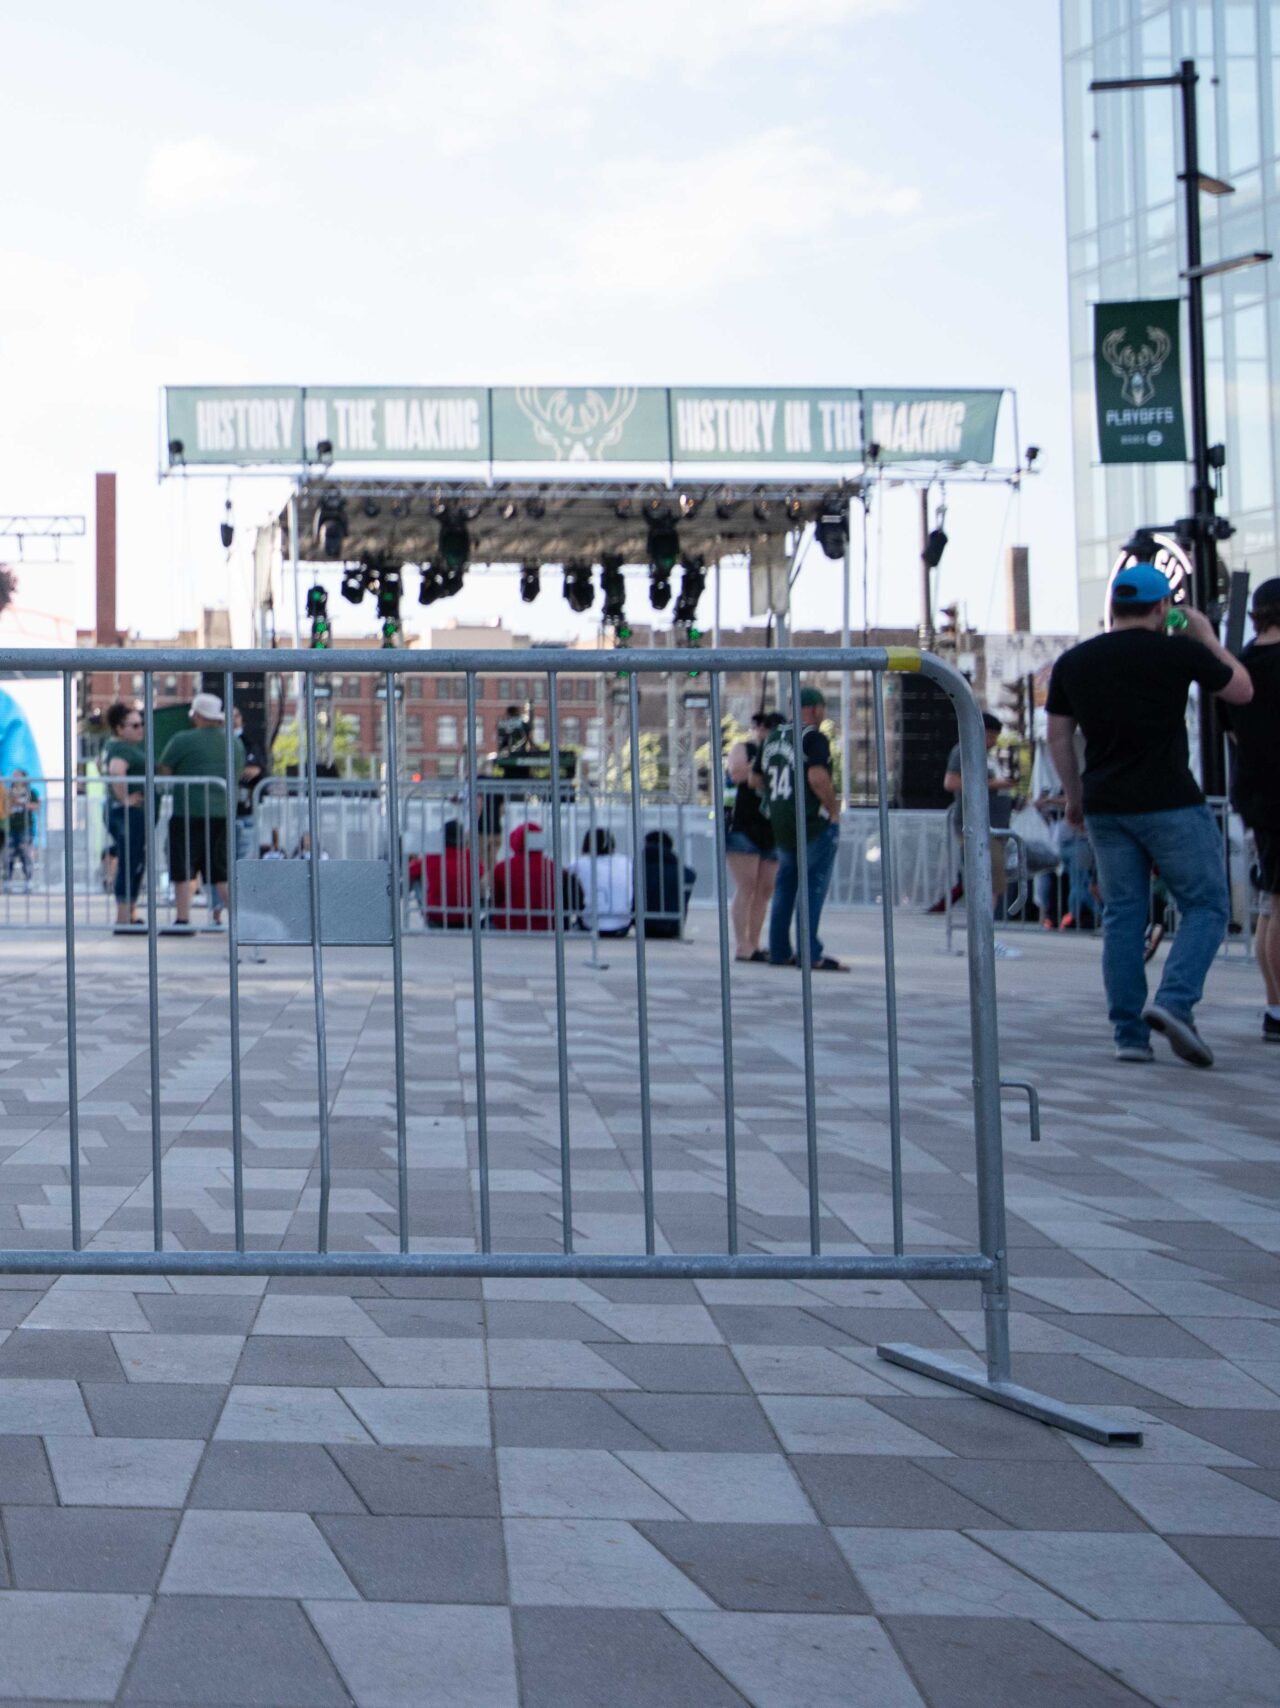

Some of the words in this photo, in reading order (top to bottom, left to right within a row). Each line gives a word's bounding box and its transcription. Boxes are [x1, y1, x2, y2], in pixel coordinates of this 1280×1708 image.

[196, 399, 295, 451] HISTORY
[334, 399, 378, 451] THE
[384, 399, 480, 451] MAKING
[677, 400, 776, 452] HISTORY
[784, 400, 812, 452] IN
[872, 401, 966, 453] MAKING
[1106, 407, 1174, 427] PLAYOFFS
[768, 765, 793, 801] 34
